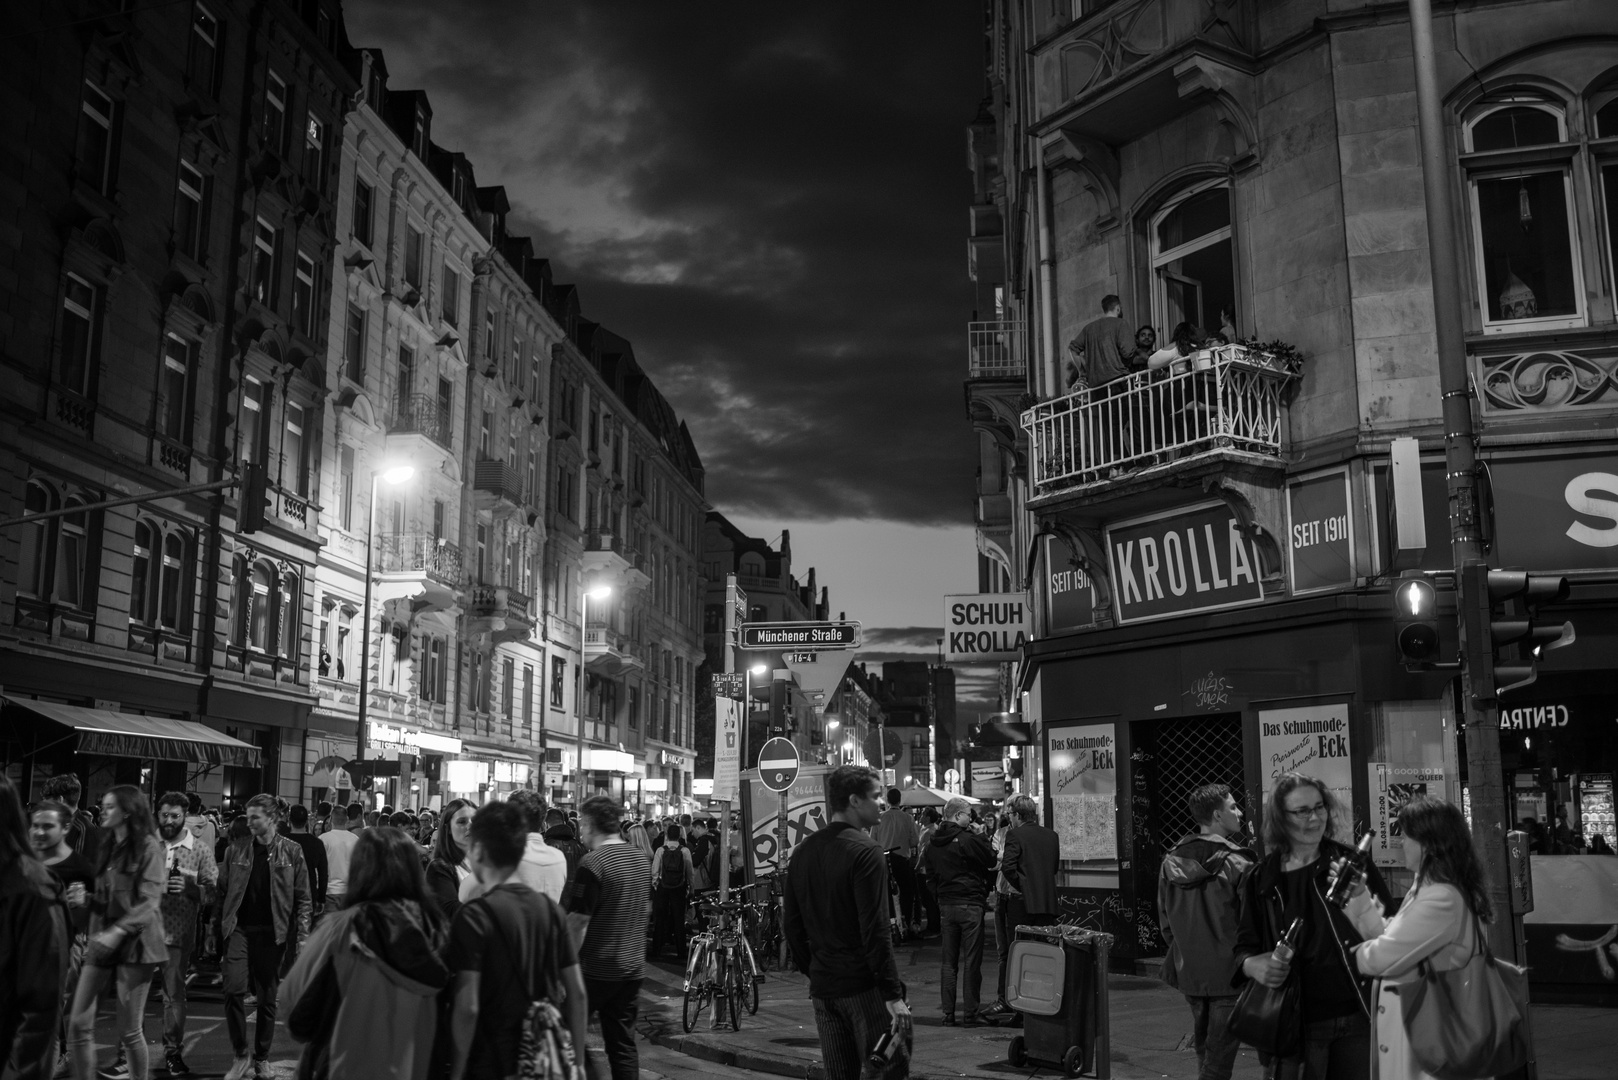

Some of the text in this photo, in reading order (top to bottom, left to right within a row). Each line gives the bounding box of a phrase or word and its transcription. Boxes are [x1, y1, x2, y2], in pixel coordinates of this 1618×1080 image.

[1293, 515, 1347, 549] SEIT 1911
[1116, 518, 1255, 605] KROLLA
[1052, 568, 1090, 594] SEIT 1911
[952, 603, 1023, 625] SCHUH
[757, 628, 843, 643] Münchener Straße
[950, 631, 1026, 653] KROLLA
[794, 654, 812, 663] 16-4
[1263, 717, 1346, 736] Das Schuhmode-
[1051, 734, 1113, 750] Das Schuhmode-
[1318, 734, 1348, 758] Eck
[1092, 749, 1114, 770] Eck
[1379, 768, 1392, 776] IT'S
